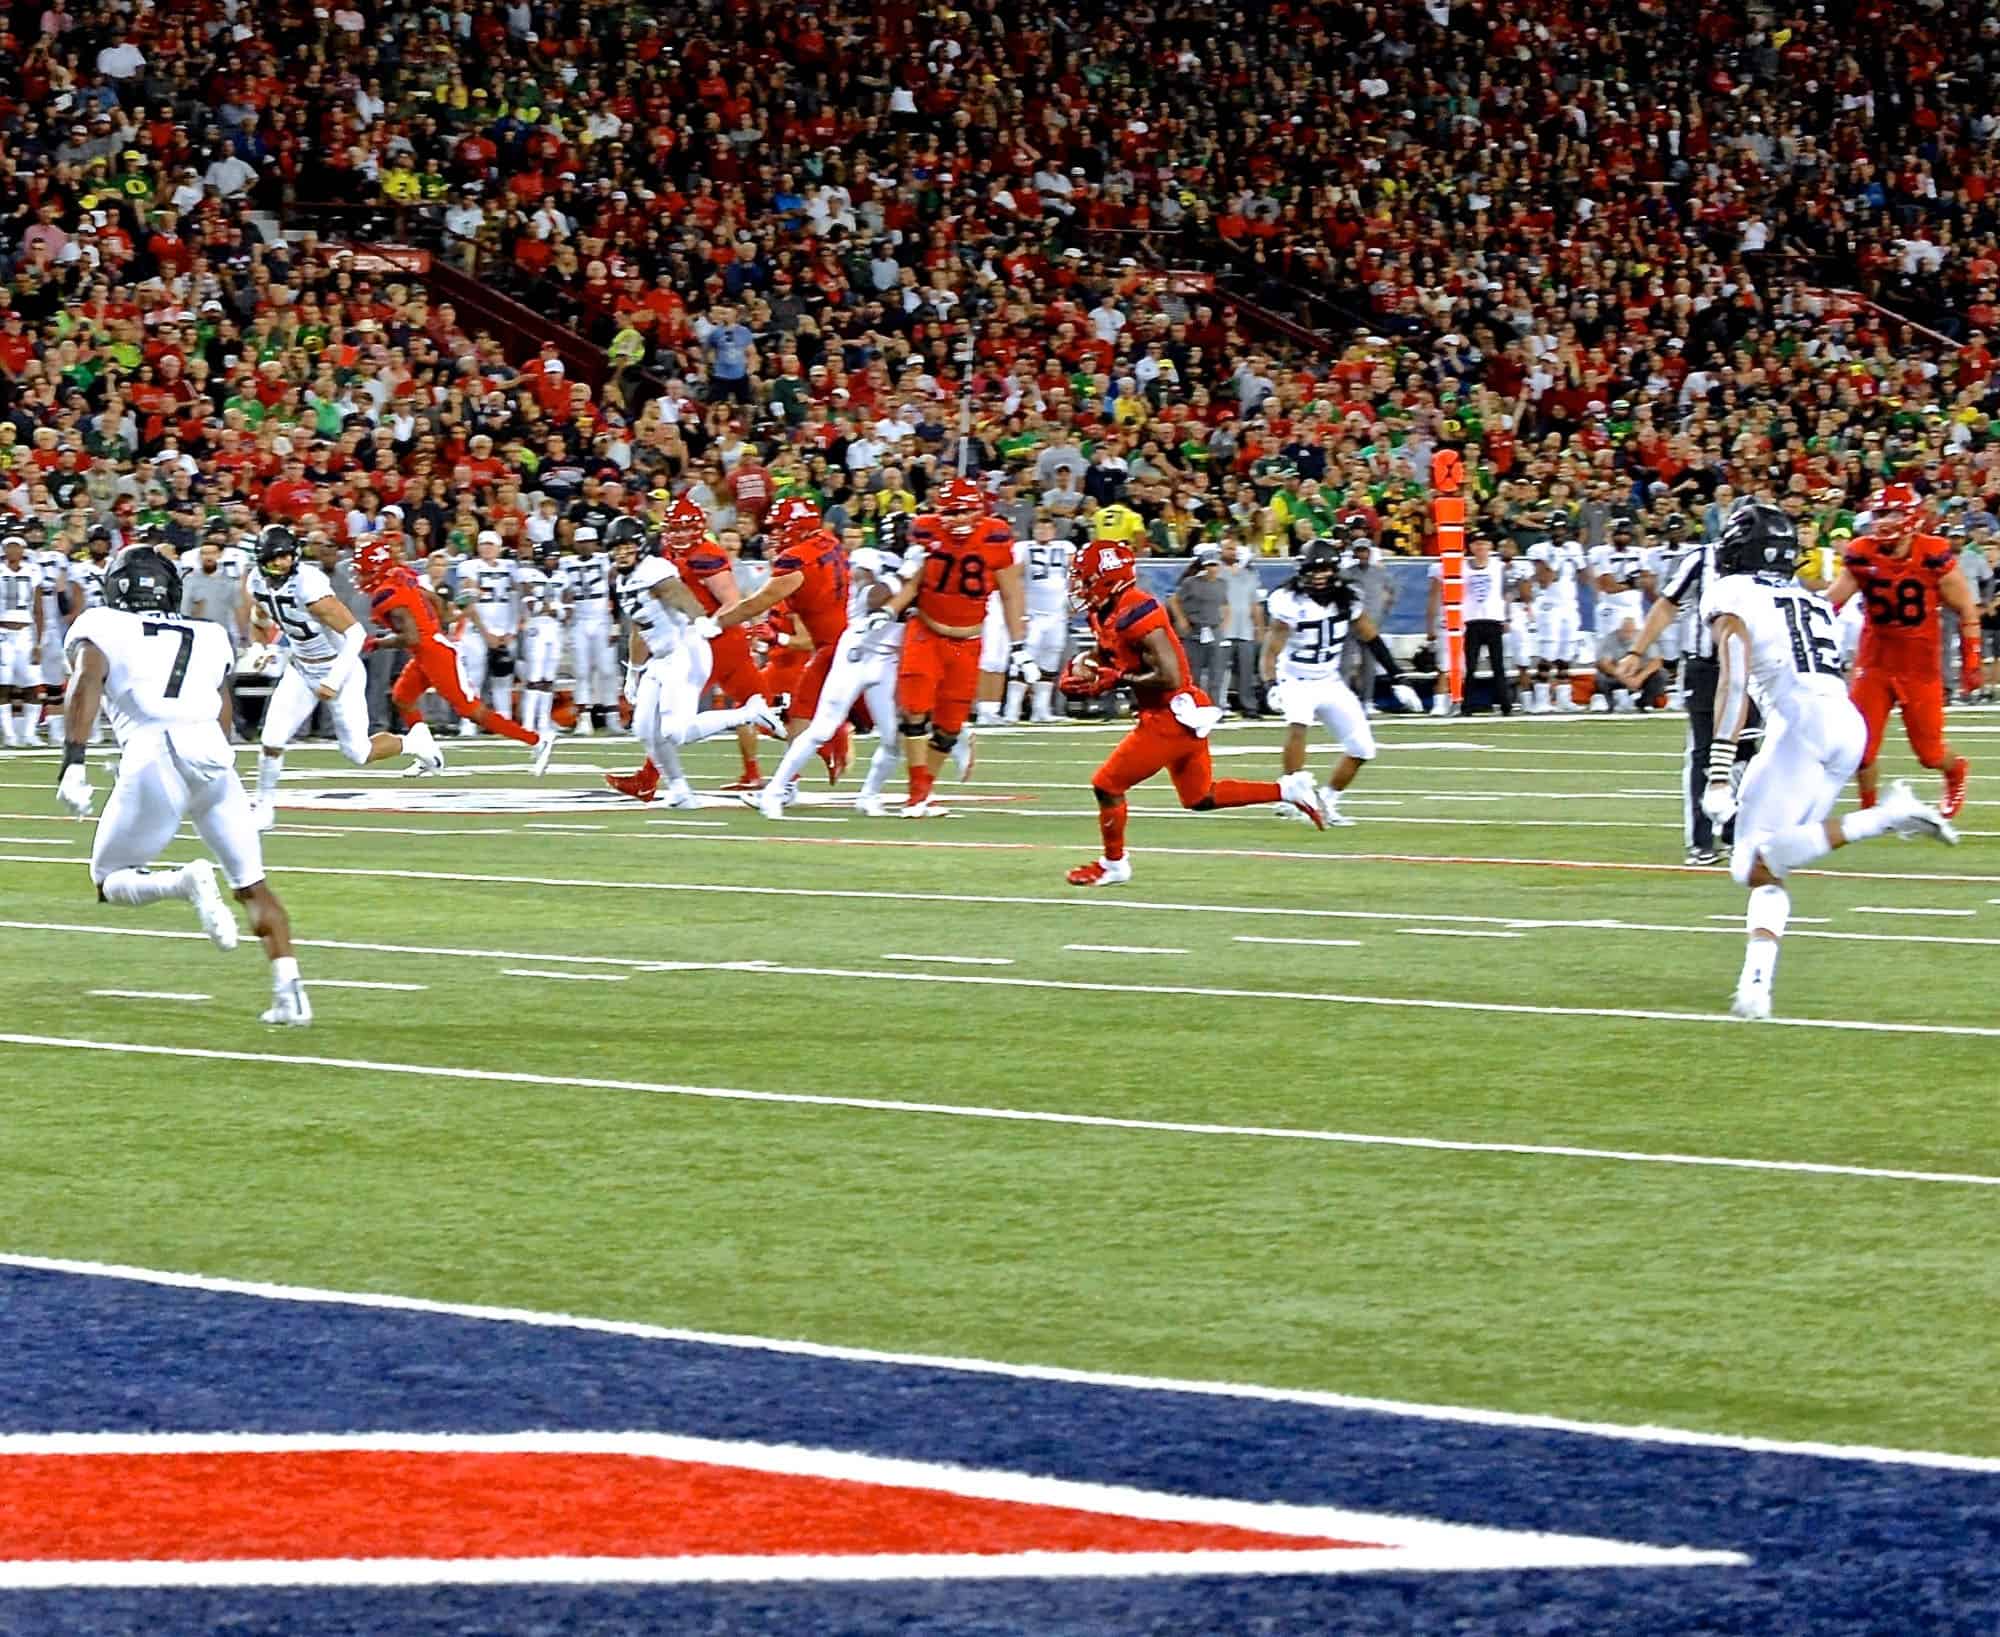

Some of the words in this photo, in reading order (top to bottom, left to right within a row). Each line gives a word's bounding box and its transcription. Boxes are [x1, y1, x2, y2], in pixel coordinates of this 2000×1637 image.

[930, 552, 985, 596] 78
[1866, 578, 1925, 626] 58
[142, 621, 195, 698] 7
[1774, 596, 1843, 676] 16
